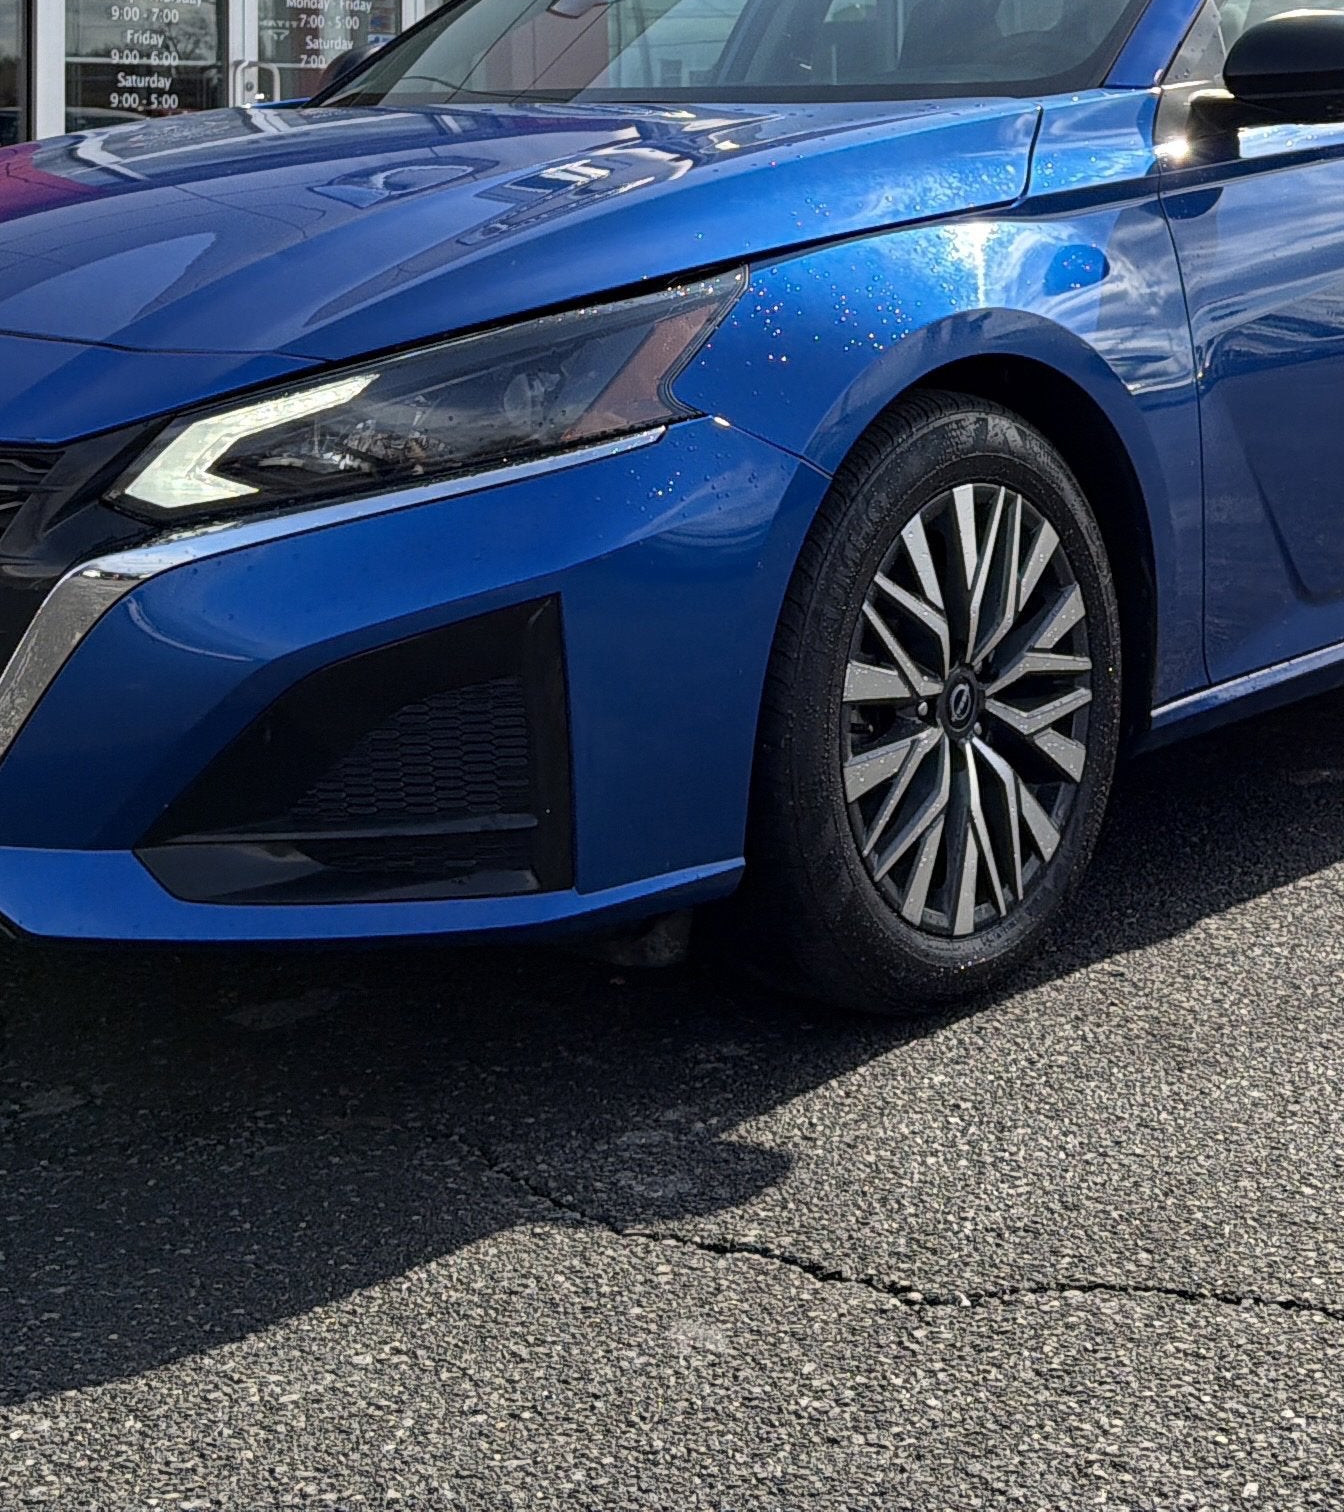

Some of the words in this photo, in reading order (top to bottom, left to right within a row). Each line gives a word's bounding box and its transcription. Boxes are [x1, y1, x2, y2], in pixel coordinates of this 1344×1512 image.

[111, 5, 140, 21] 9:00
[151, 8, 180, 23] 7:00
[299, 14, 325, 28] 7:00
[335, 15, 360, 29] 5:00
[126, 29, 165, 47] Friday
[305, 34, 354, 51] Saturday
[111, 49, 140, 65] 9:00
[150, 50, 179, 66] 6:00
[300, 54, 326, 67] 7:00
[117, 71, 172, 91] Saturday
[110, 93, 139, 108] 9:00
[150, 93, 178, 108] 5:00
